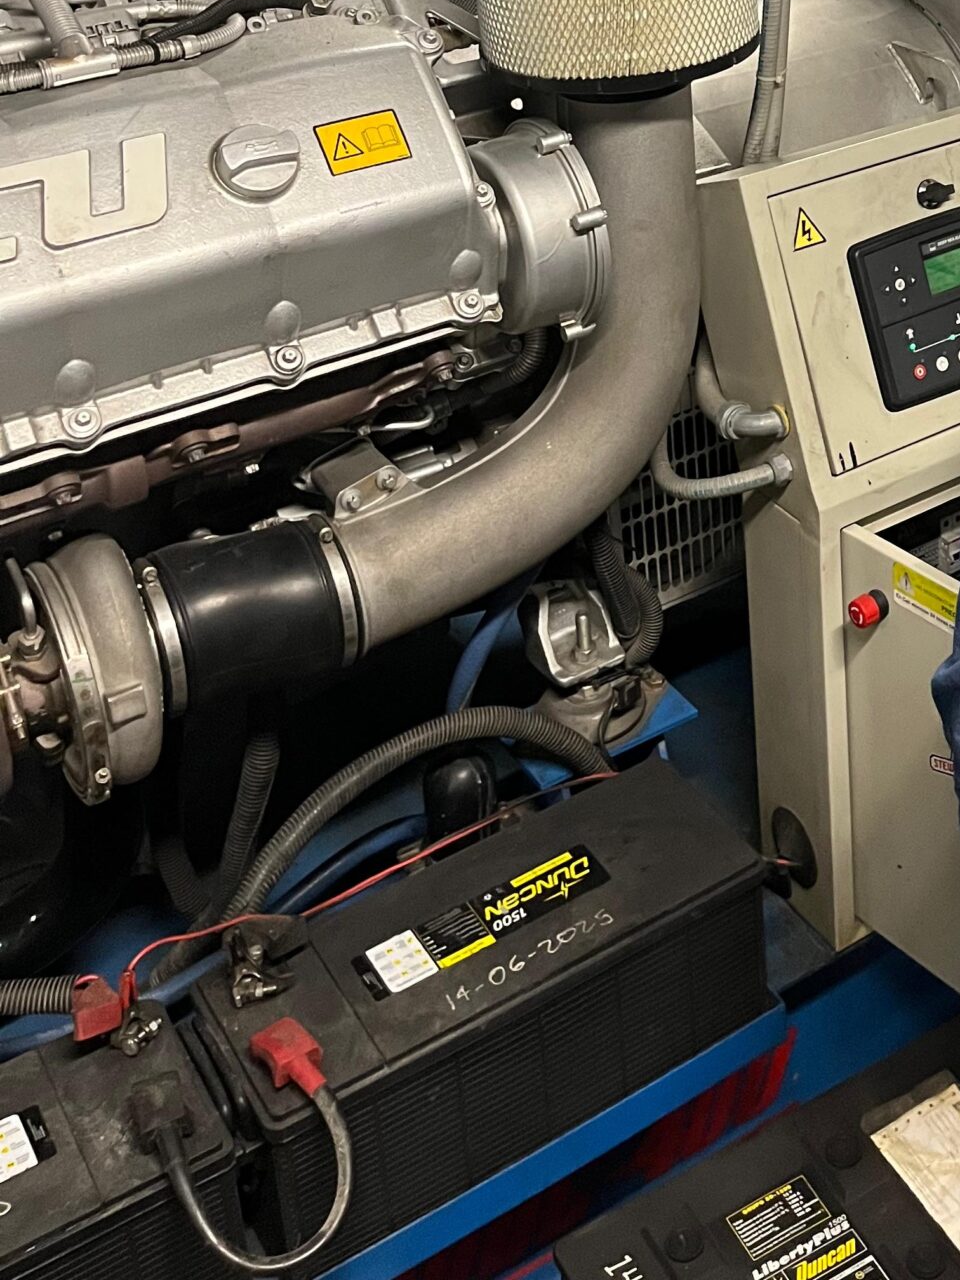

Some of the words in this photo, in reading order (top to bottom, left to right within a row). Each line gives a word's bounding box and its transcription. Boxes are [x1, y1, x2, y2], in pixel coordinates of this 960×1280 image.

[492, 907, 527, 932] 1500
[445, 908, 614, 1011] 14-06-2025
[828, 1213, 847, 1228] 1500
[796, 1237, 856, 1280] Duncan
